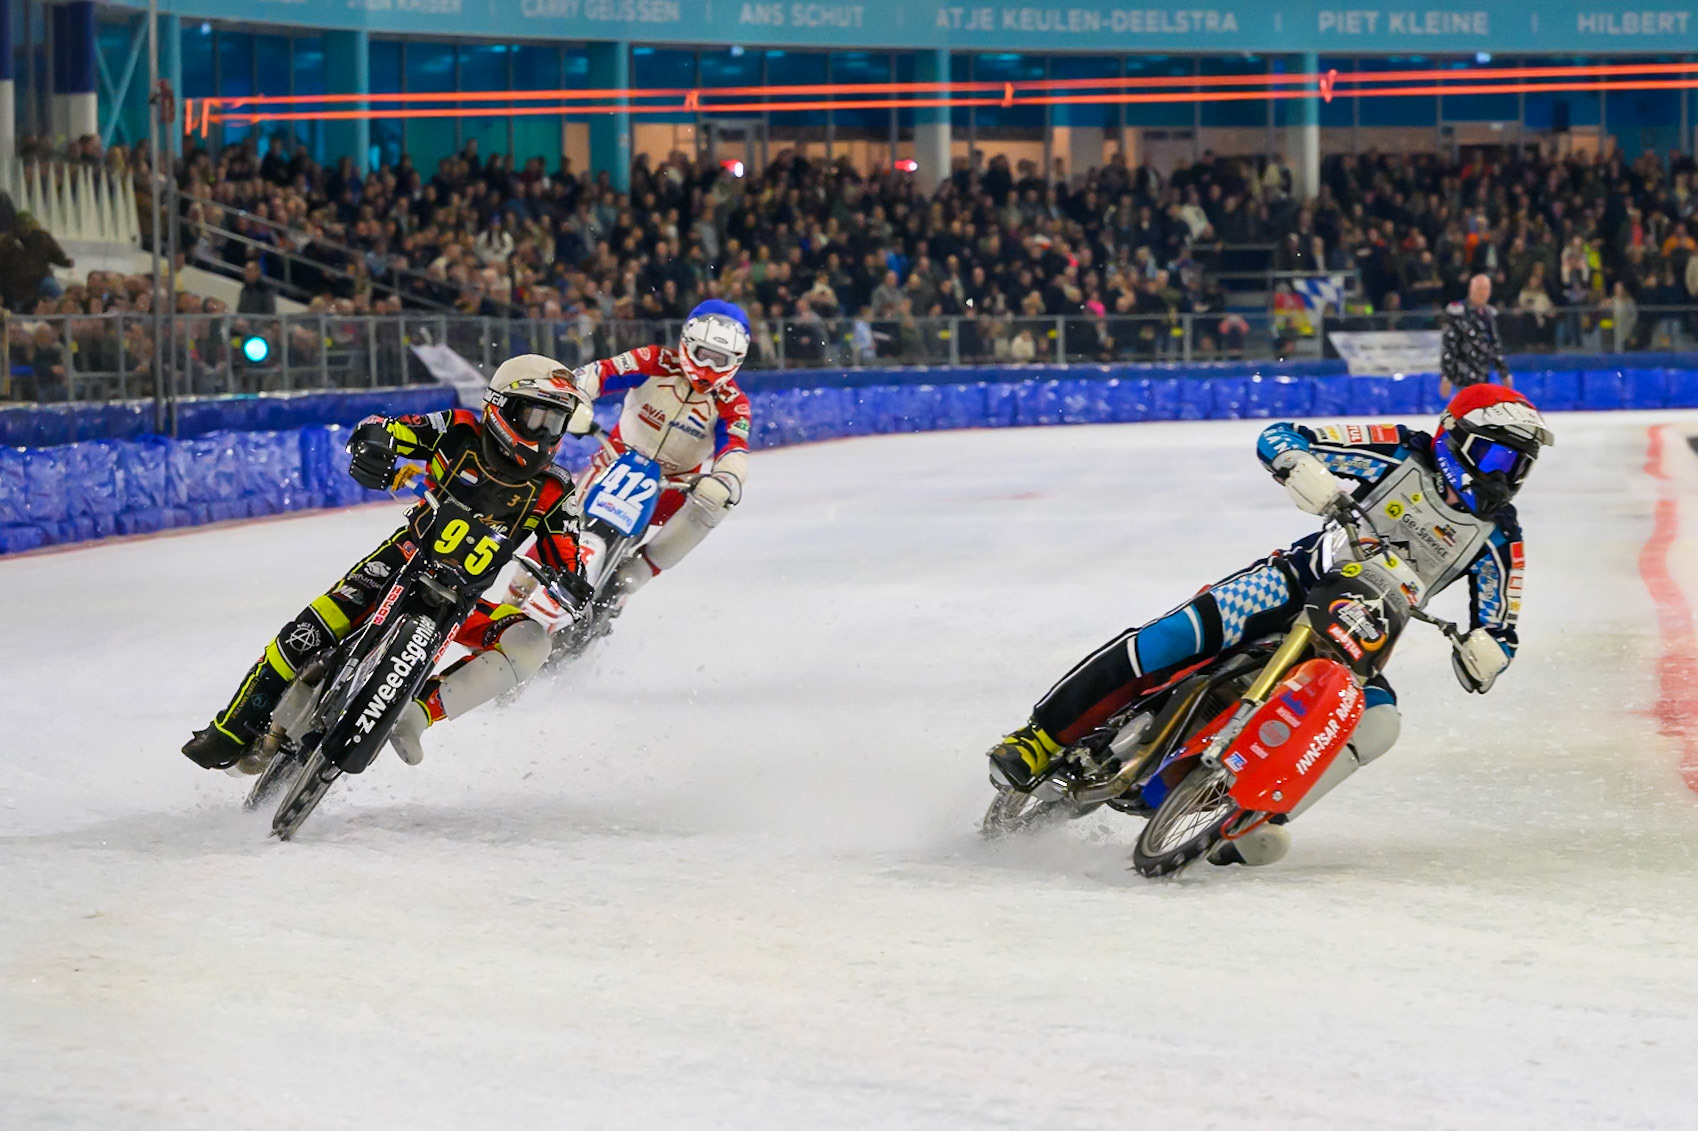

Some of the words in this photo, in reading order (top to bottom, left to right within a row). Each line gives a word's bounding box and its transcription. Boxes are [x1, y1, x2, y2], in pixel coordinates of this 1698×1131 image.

[738, 3, 785, 25] ANS
[791, 5, 863, 27] SCHUT
[936, 8, 994, 31] ATJE
[1002, 9, 1239, 33] KEULEN-DEELSTRA
[1318, 11, 1380, 34] PIET
[1389, 11, 1489, 34] KLEINE
[1577, 13, 1690, 35] HILBERT
[600, 463, 659, 509] 412
[507, 494, 521, 507] 3
